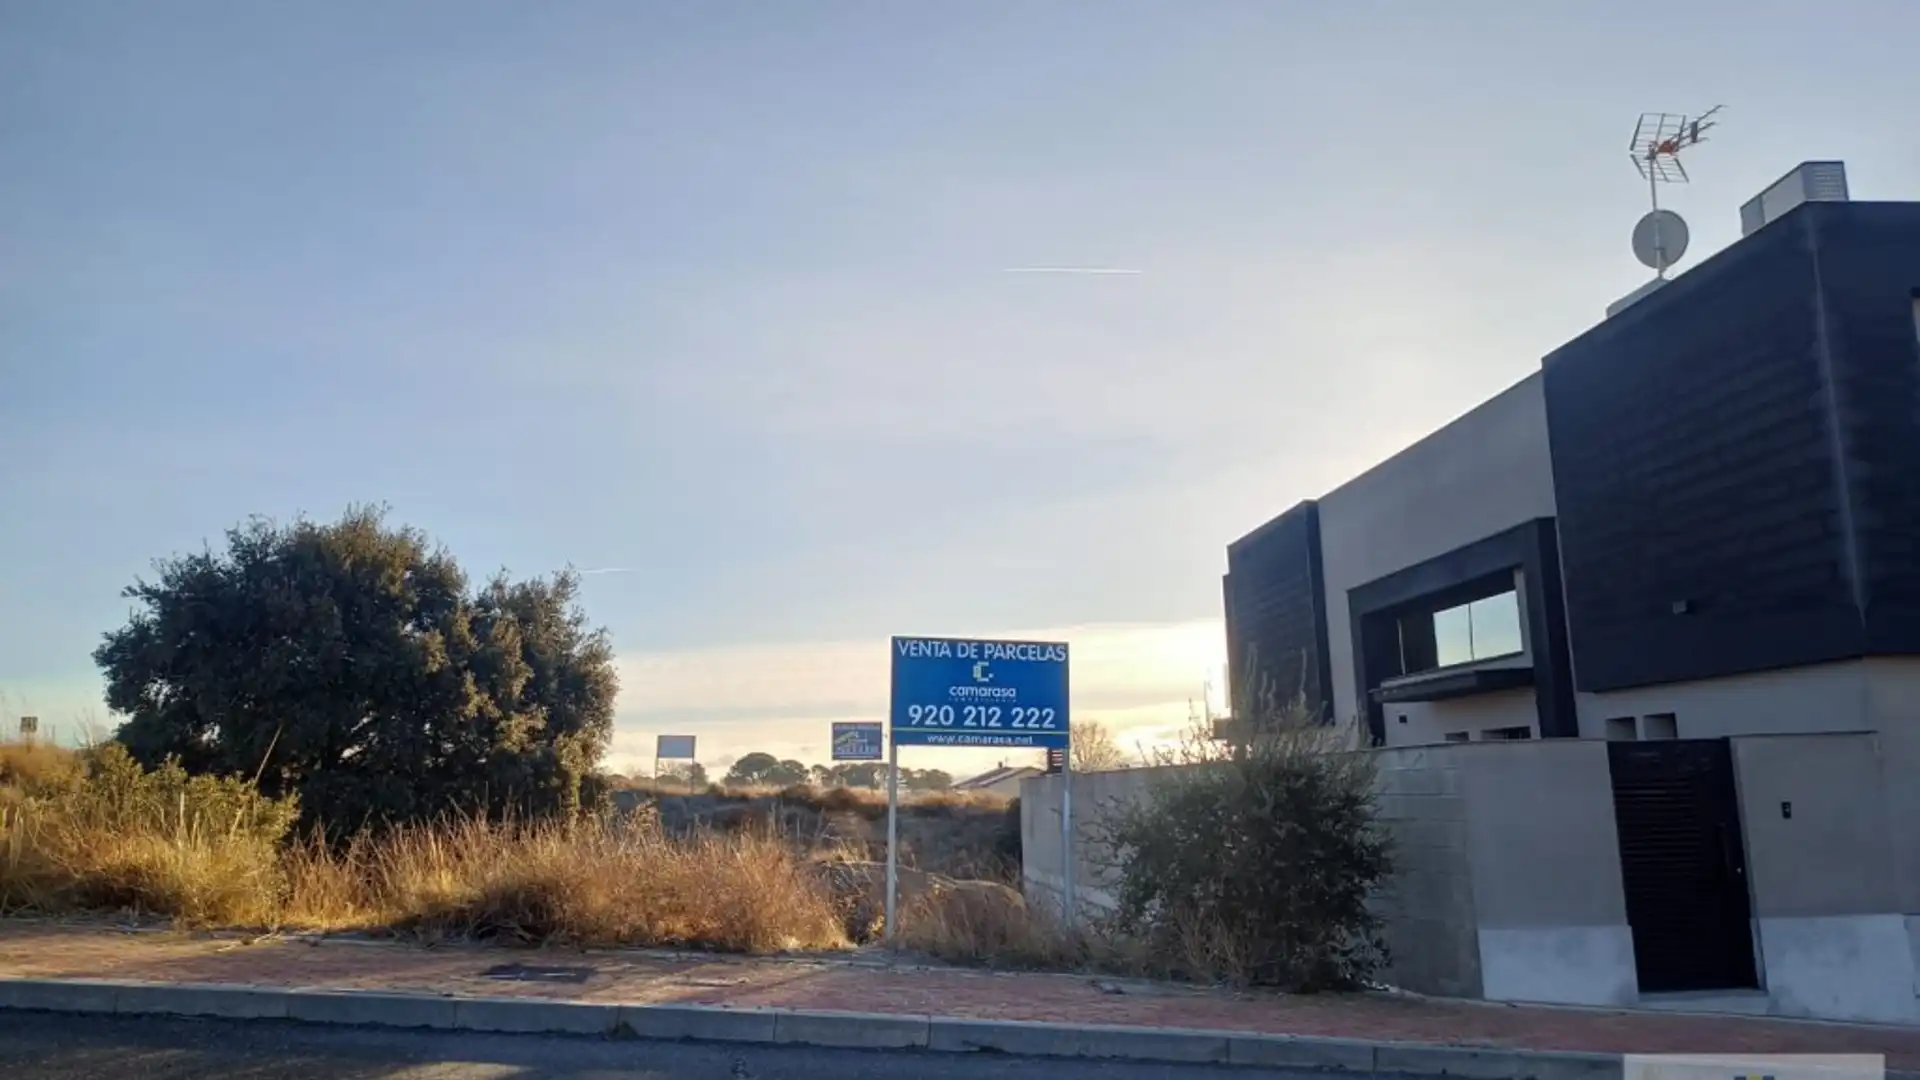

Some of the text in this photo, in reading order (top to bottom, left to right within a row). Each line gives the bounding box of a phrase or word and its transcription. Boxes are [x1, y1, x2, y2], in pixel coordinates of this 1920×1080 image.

[897, 640, 1066, 661] VENTA DE PARCELAS
[949, 685, 1016, 697] camarasa
[908, 704, 1056, 729] 920 212 222
[927, 733, 1033, 745] www.camarasa.net
